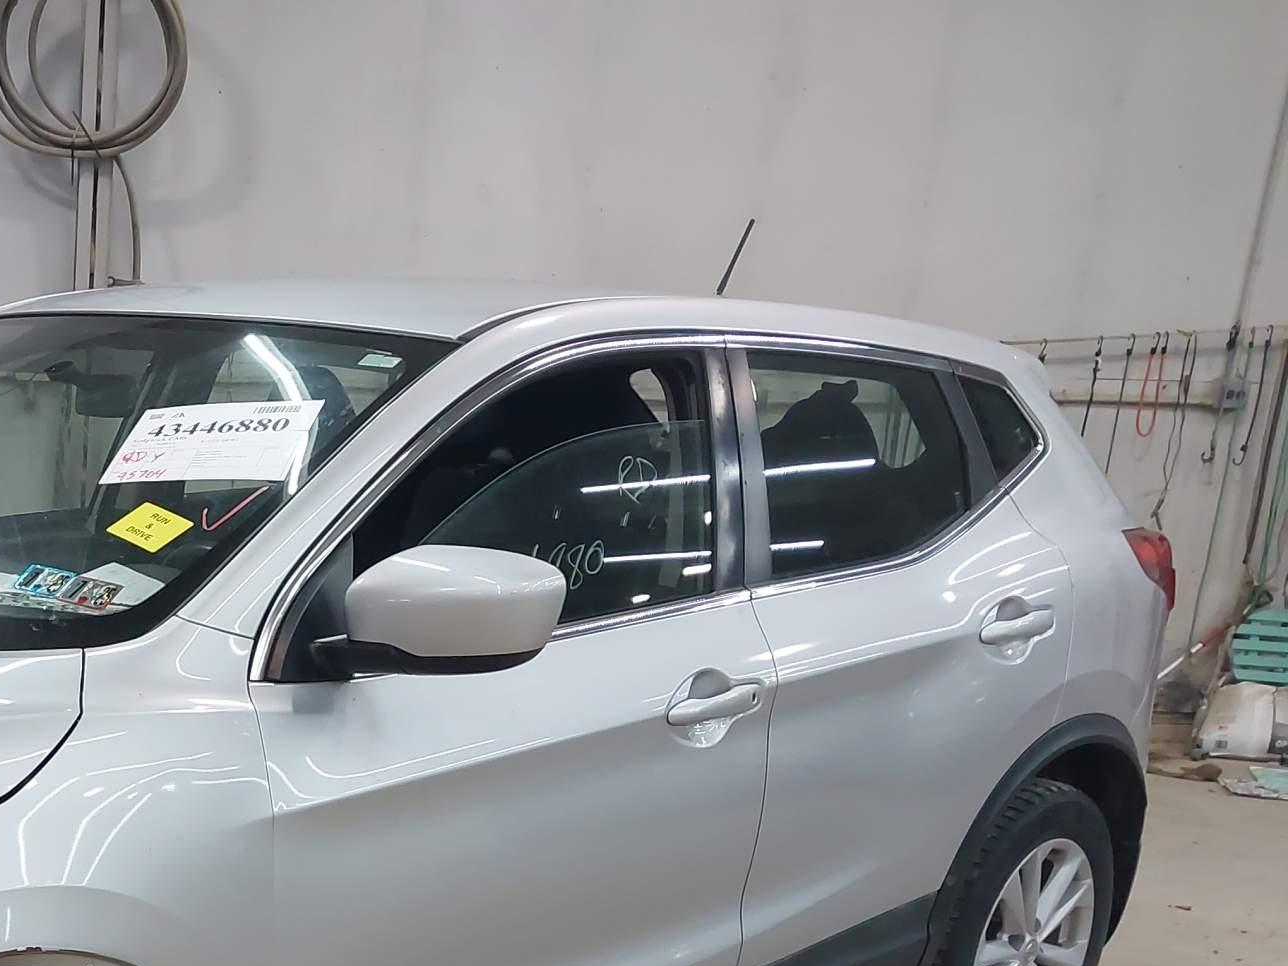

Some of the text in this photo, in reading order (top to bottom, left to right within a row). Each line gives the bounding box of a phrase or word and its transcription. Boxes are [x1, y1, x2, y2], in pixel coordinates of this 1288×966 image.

[148, 417, 291, 438] 43446880
[150, 512, 172, 525] RUN
[125, 525, 154, 542] DRIVE
